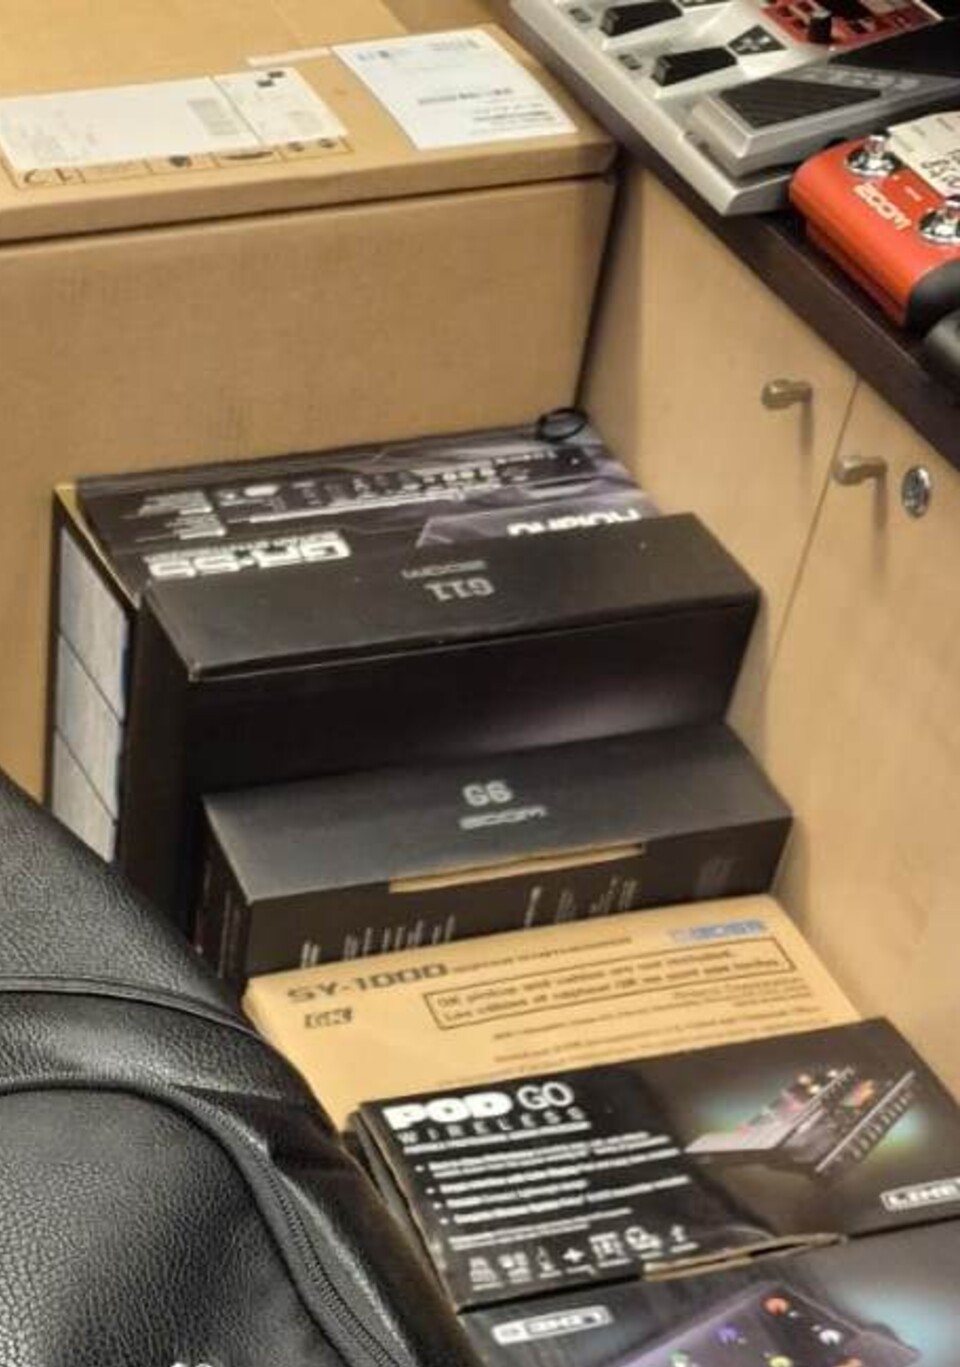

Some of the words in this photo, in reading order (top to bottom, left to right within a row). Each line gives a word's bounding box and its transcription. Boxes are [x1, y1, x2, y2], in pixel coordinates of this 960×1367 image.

[425, 575, 495, 601] G11
[462, 780, 514, 807] G6
[287, 963, 448, 1004] SY-1000
[382, 1092, 513, 1130] POD
[517, 1081, 574, 1110] GO
